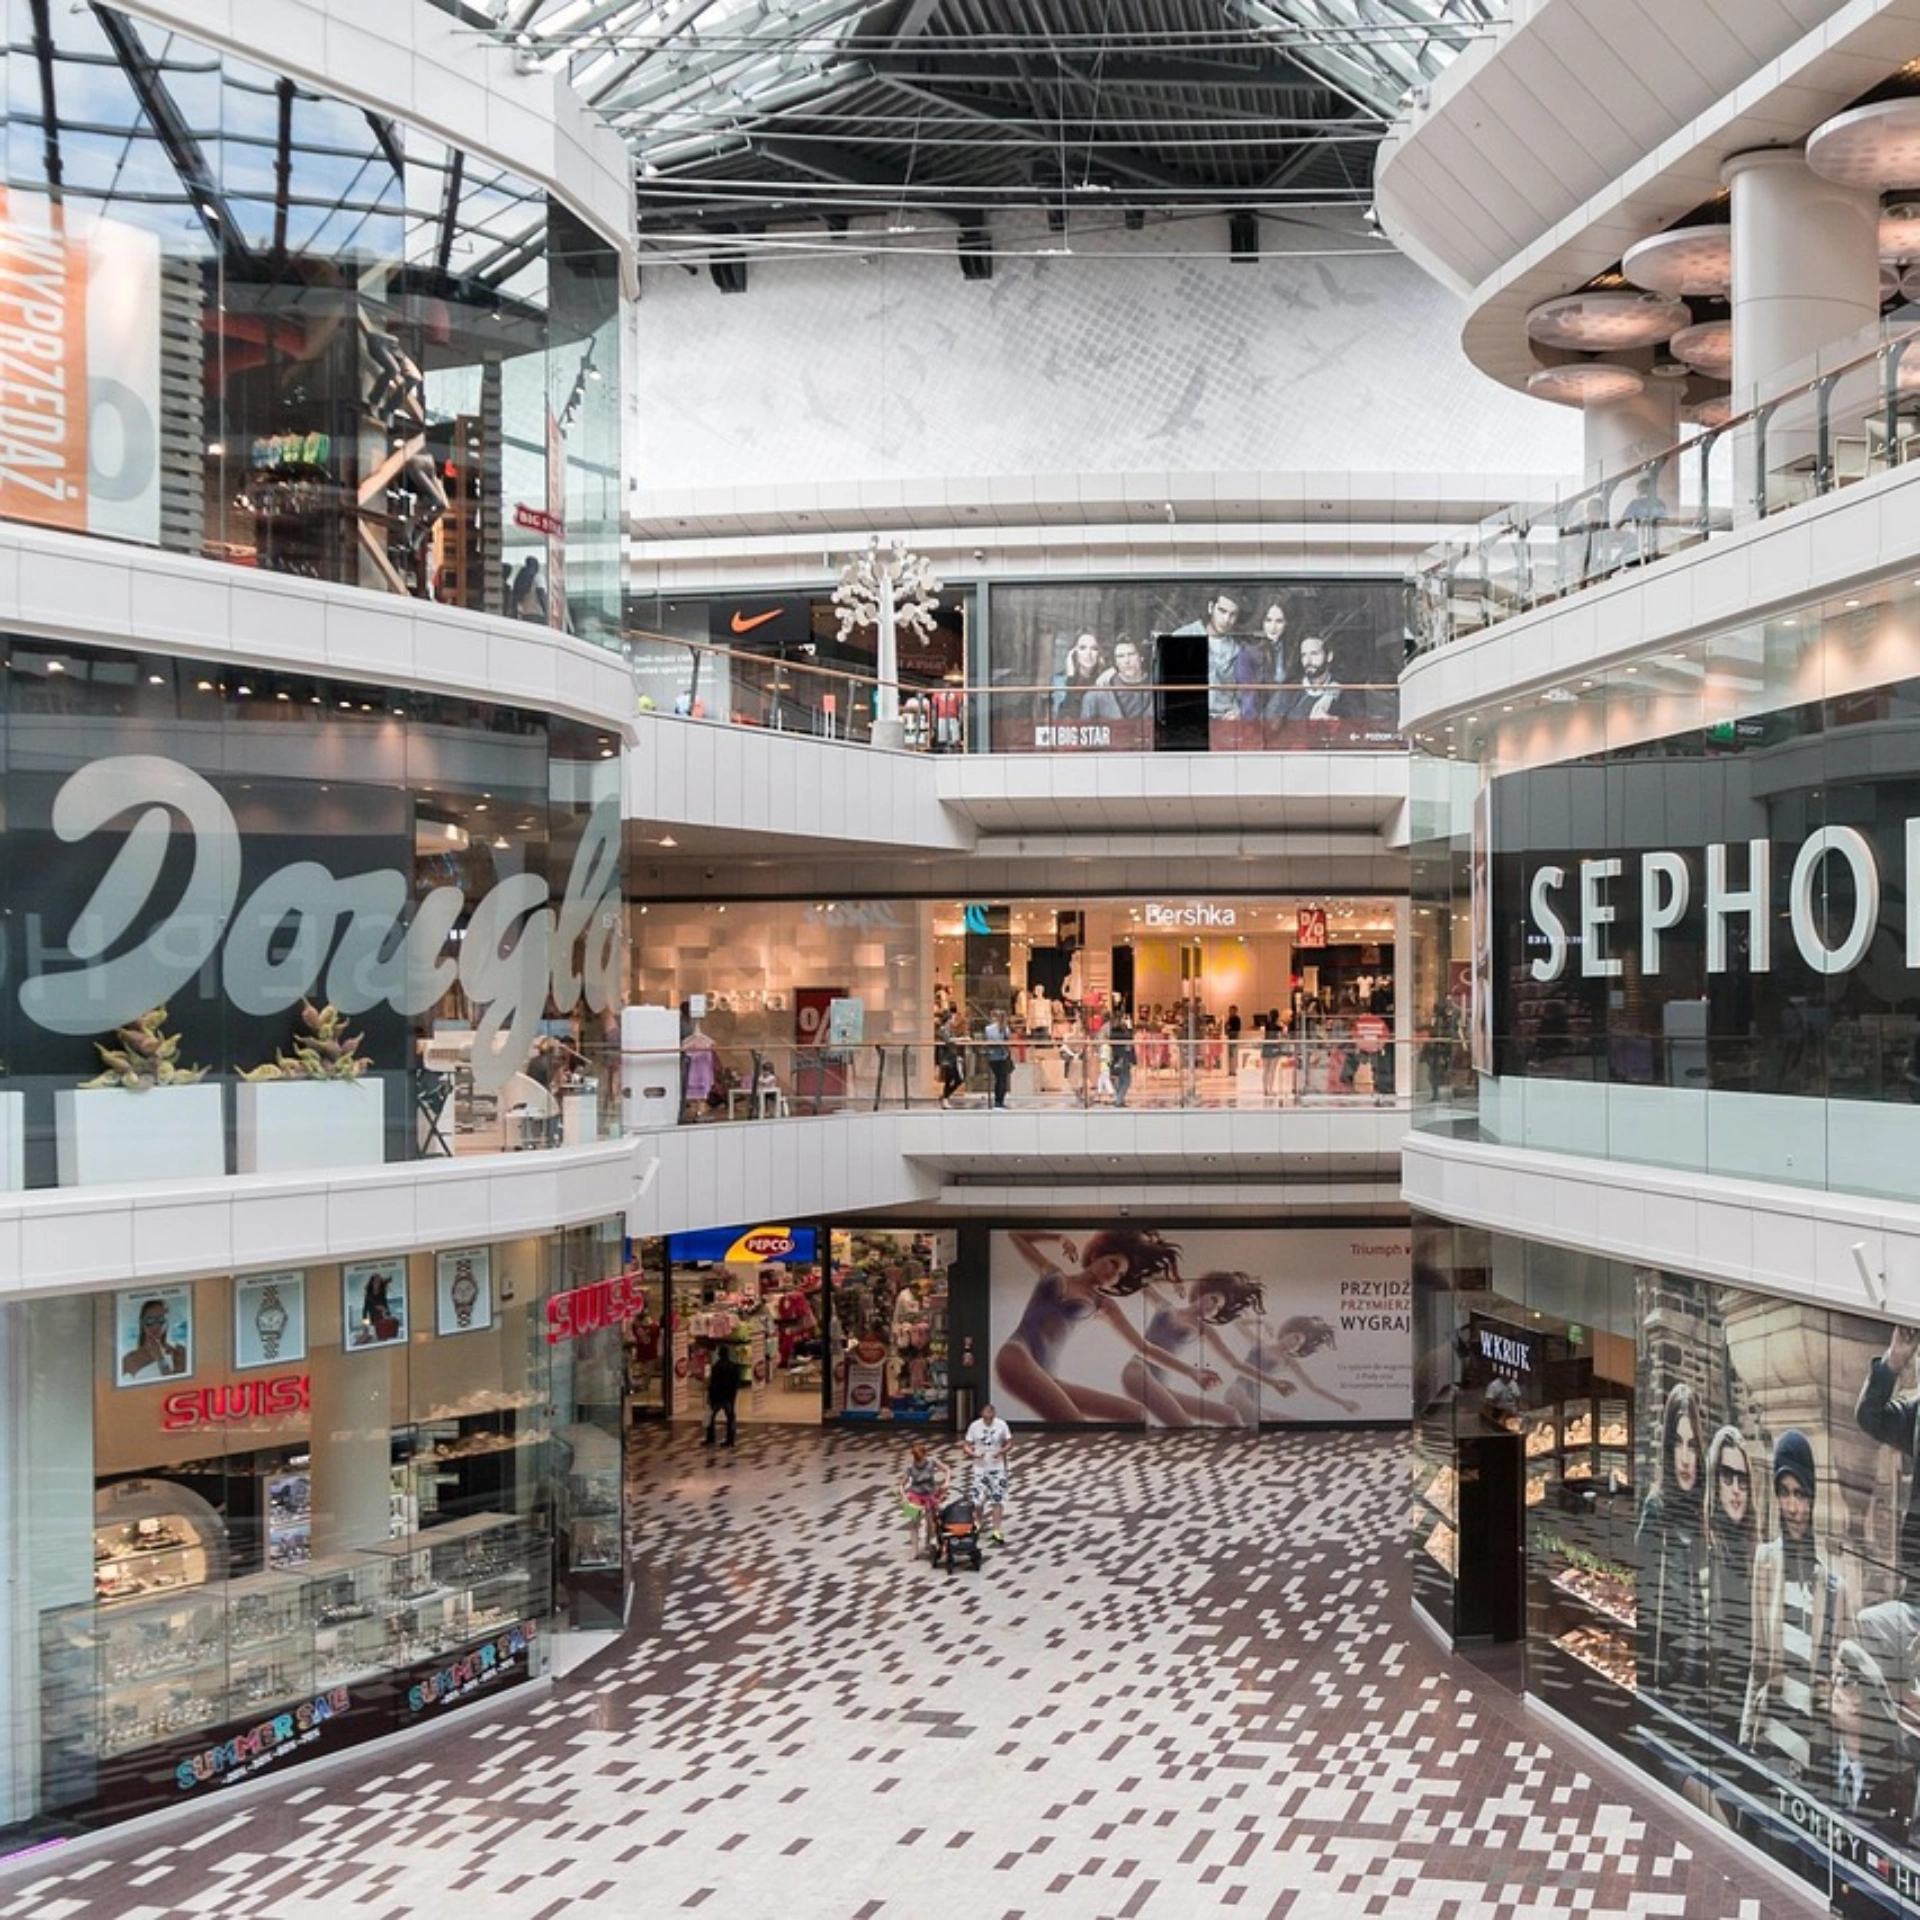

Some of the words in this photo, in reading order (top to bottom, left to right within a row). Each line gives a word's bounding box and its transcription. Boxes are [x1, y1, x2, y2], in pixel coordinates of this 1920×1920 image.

[1057, 726, 1079, 746] BIG
[1080, 726, 1110, 746] STAR
[1530, 816, 1920, 982] SEPHO
[1145, 904, 1235, 927] Bershka
[748, 1239, 788, 1252] PEPCO
[1350, 1244, 1402, 1258] Triumph
[1341, 1279, 1411, 1297] PRZYJDŹ
[546, 1271, 644, 1344] SWISS
[1341, 1299, 1411, 1311] PRZYMIERZ
[1340, 1315, 1410, 1333] WYGRAJ
[164, 1374, 310, 1431] SWIS
[408, 1644, 496, 1711] SUMMER
[175, 1713, 294, 1789] SUMMER
[296, 1684, 349, 1730] SALE
